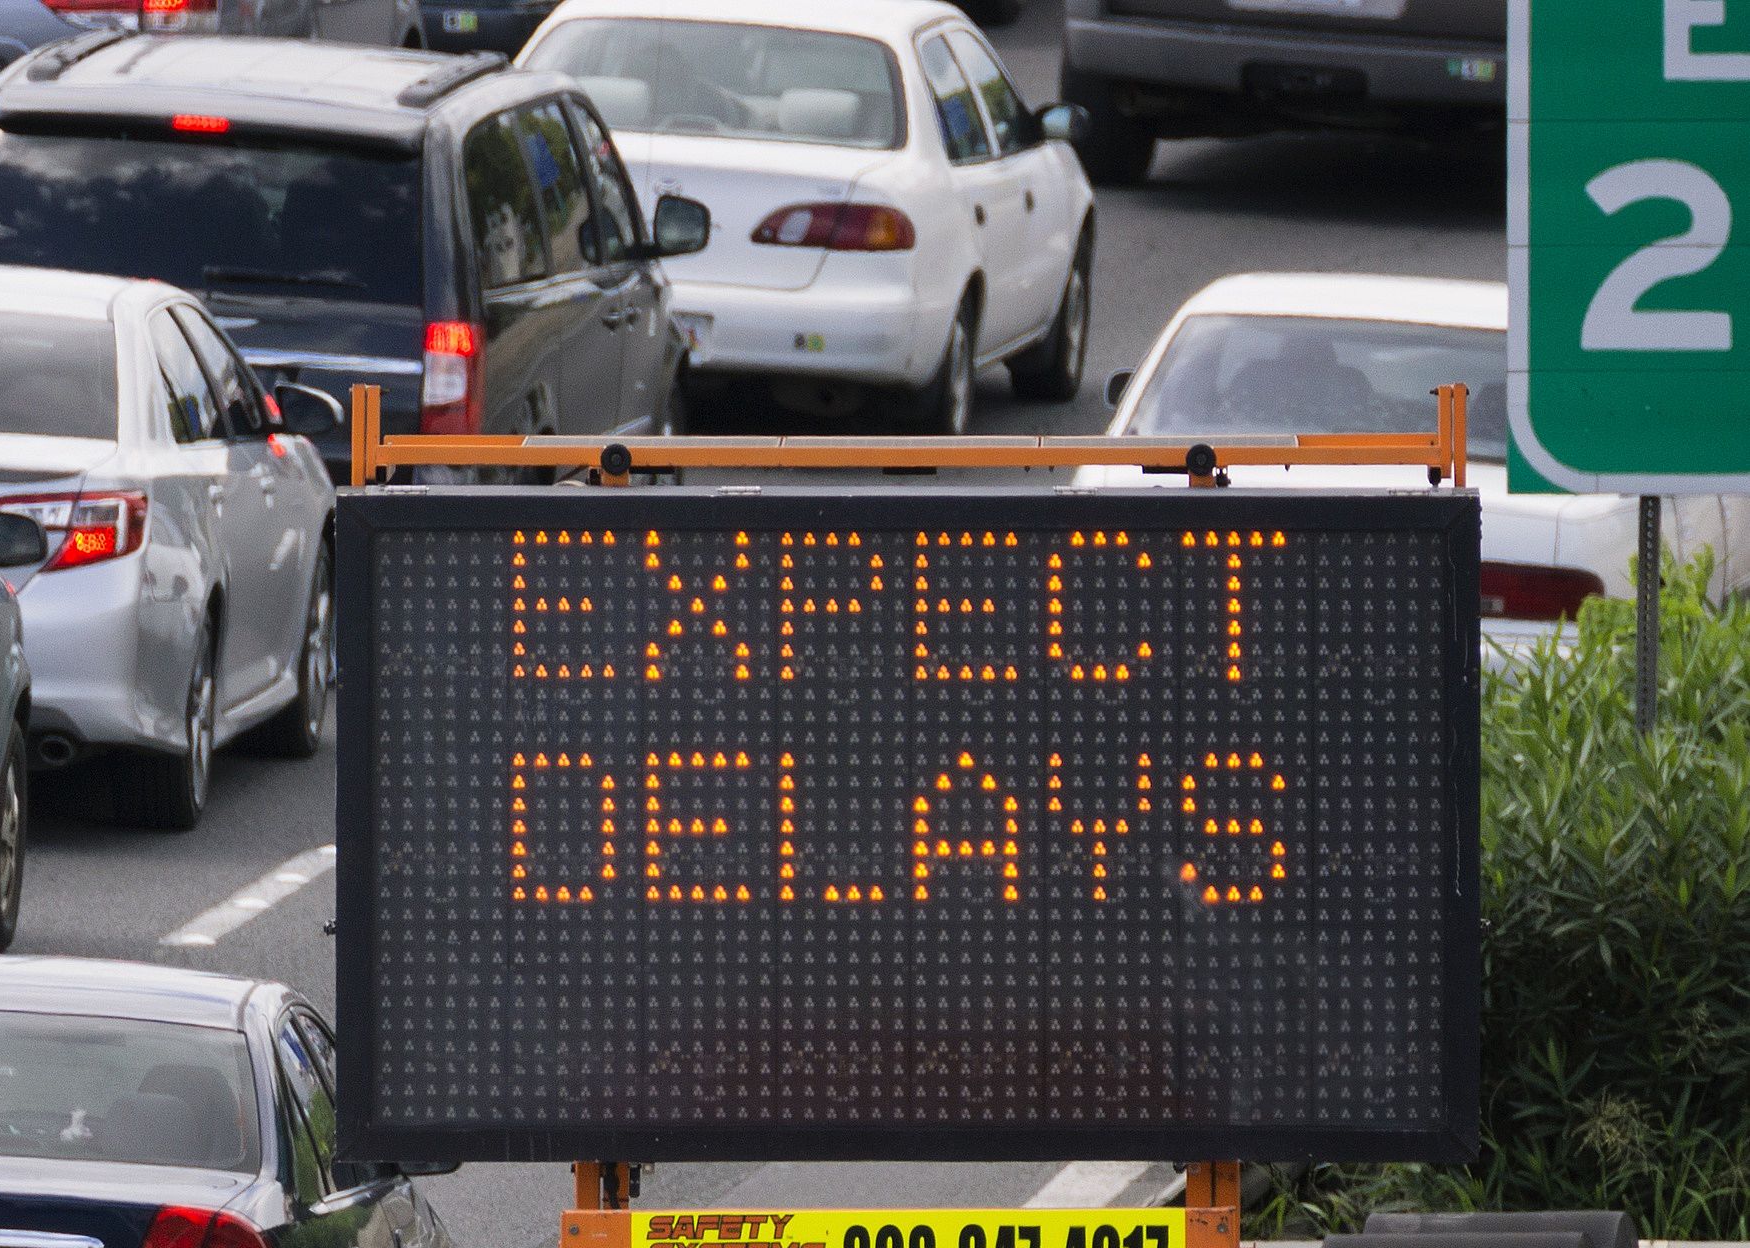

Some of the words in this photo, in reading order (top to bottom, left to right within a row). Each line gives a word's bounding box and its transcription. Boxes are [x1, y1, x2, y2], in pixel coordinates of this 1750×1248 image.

[1581, 158, 1732, 351] 2
[513, 530, 1286, 680] EXPECT
[513, 752, 1286, 903] DELAYS
[646, 1214, 794, 1241] SAFETY
